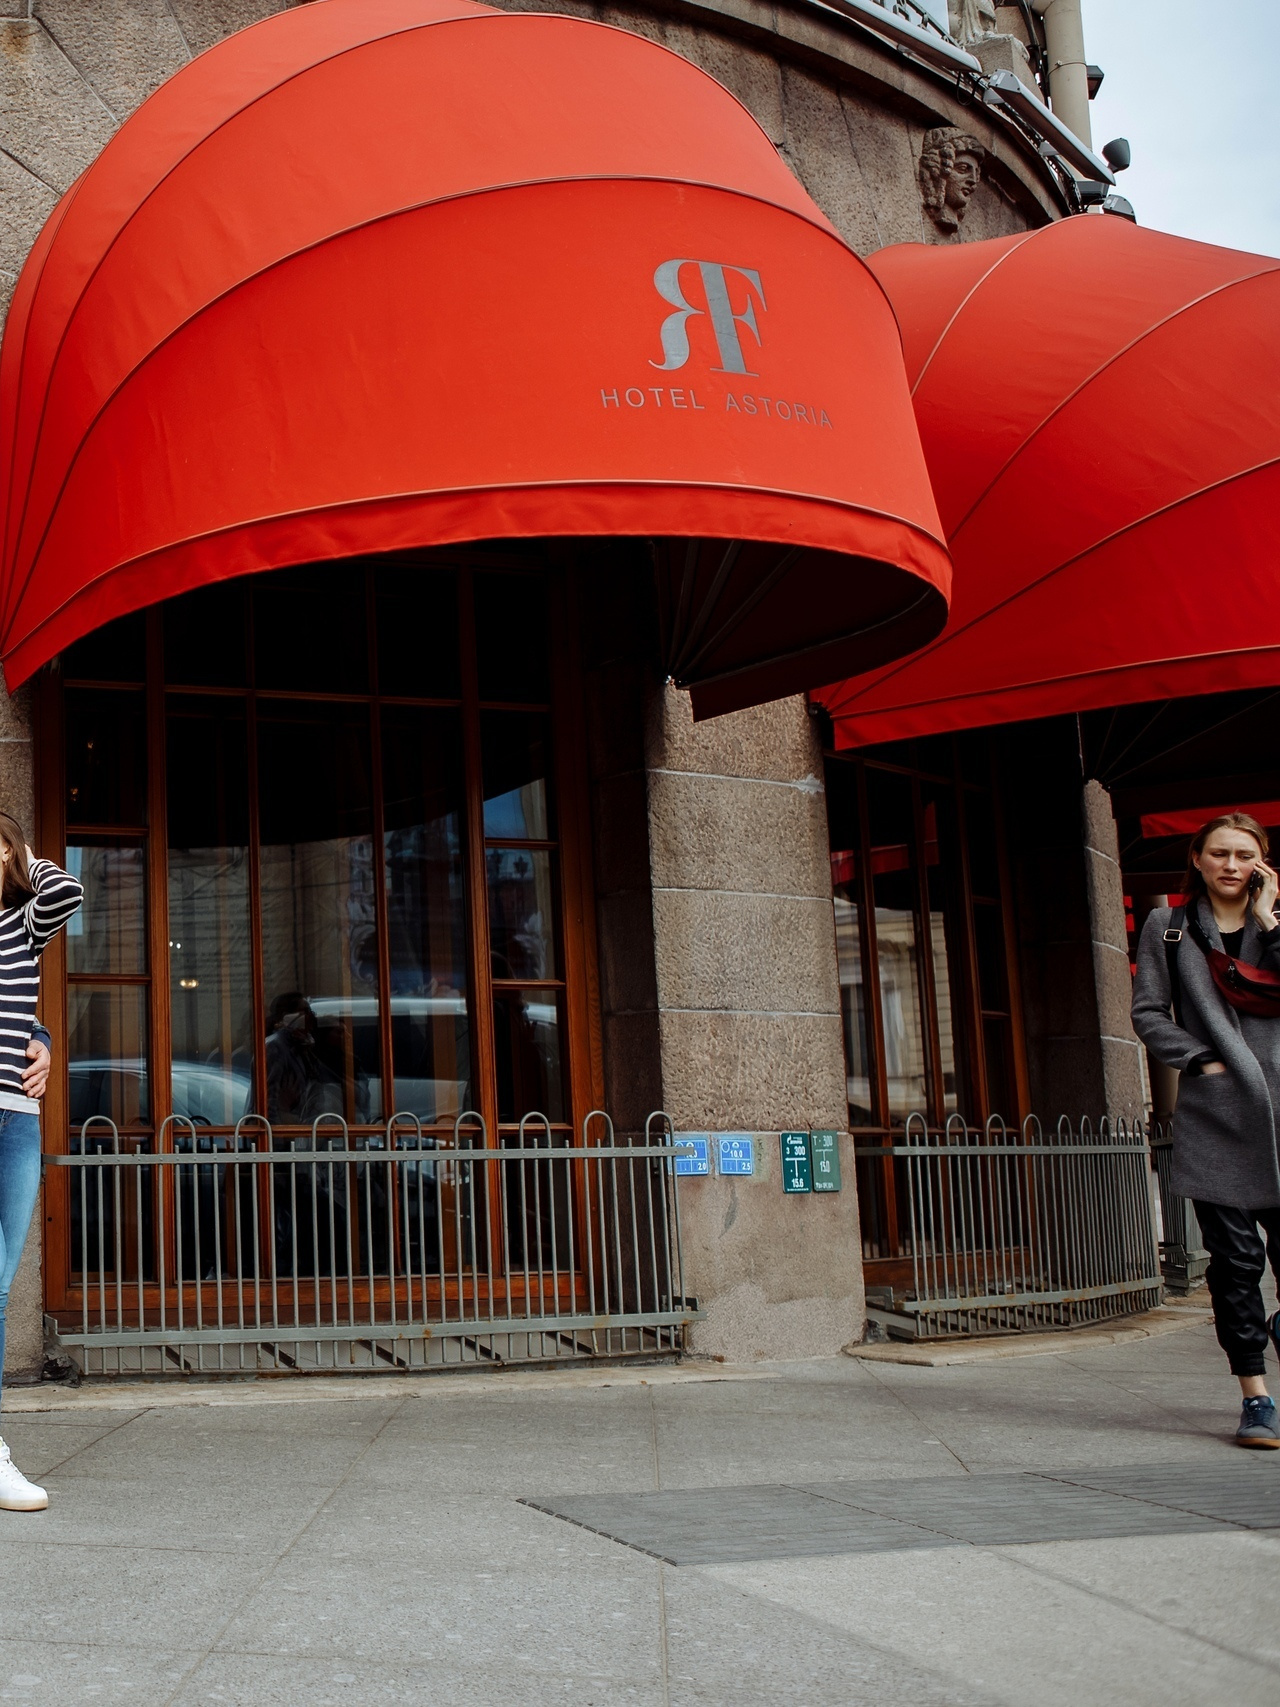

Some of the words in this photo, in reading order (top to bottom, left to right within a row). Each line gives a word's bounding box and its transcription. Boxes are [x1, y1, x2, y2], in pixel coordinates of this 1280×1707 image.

[600, 387, 705, 409] HOTEL
[725, 393, 834, 430] ASTORIA
[794, 1145, 806, 1156] 300
